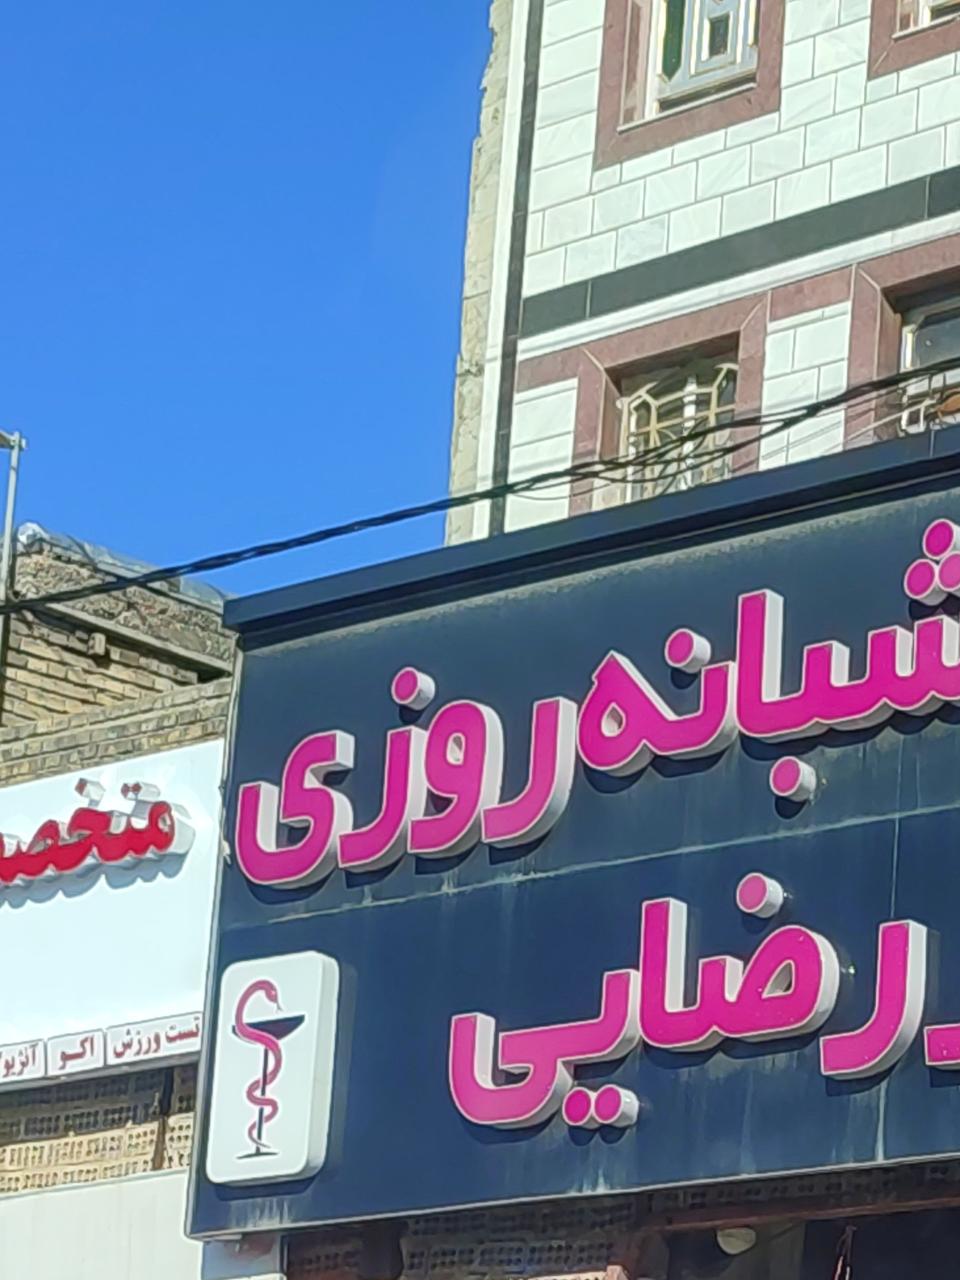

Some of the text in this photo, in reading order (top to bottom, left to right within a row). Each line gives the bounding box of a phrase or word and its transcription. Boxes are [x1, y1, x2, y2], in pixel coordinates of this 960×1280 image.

[235, 667, 577, 887] روزی
[0, 778, 178, 885] متخص
[58, 1035, 95, 1070] اکو
[113, 1016, 201, 1059] تست ورزش
[448, 872, 925, 1131] رضایی
